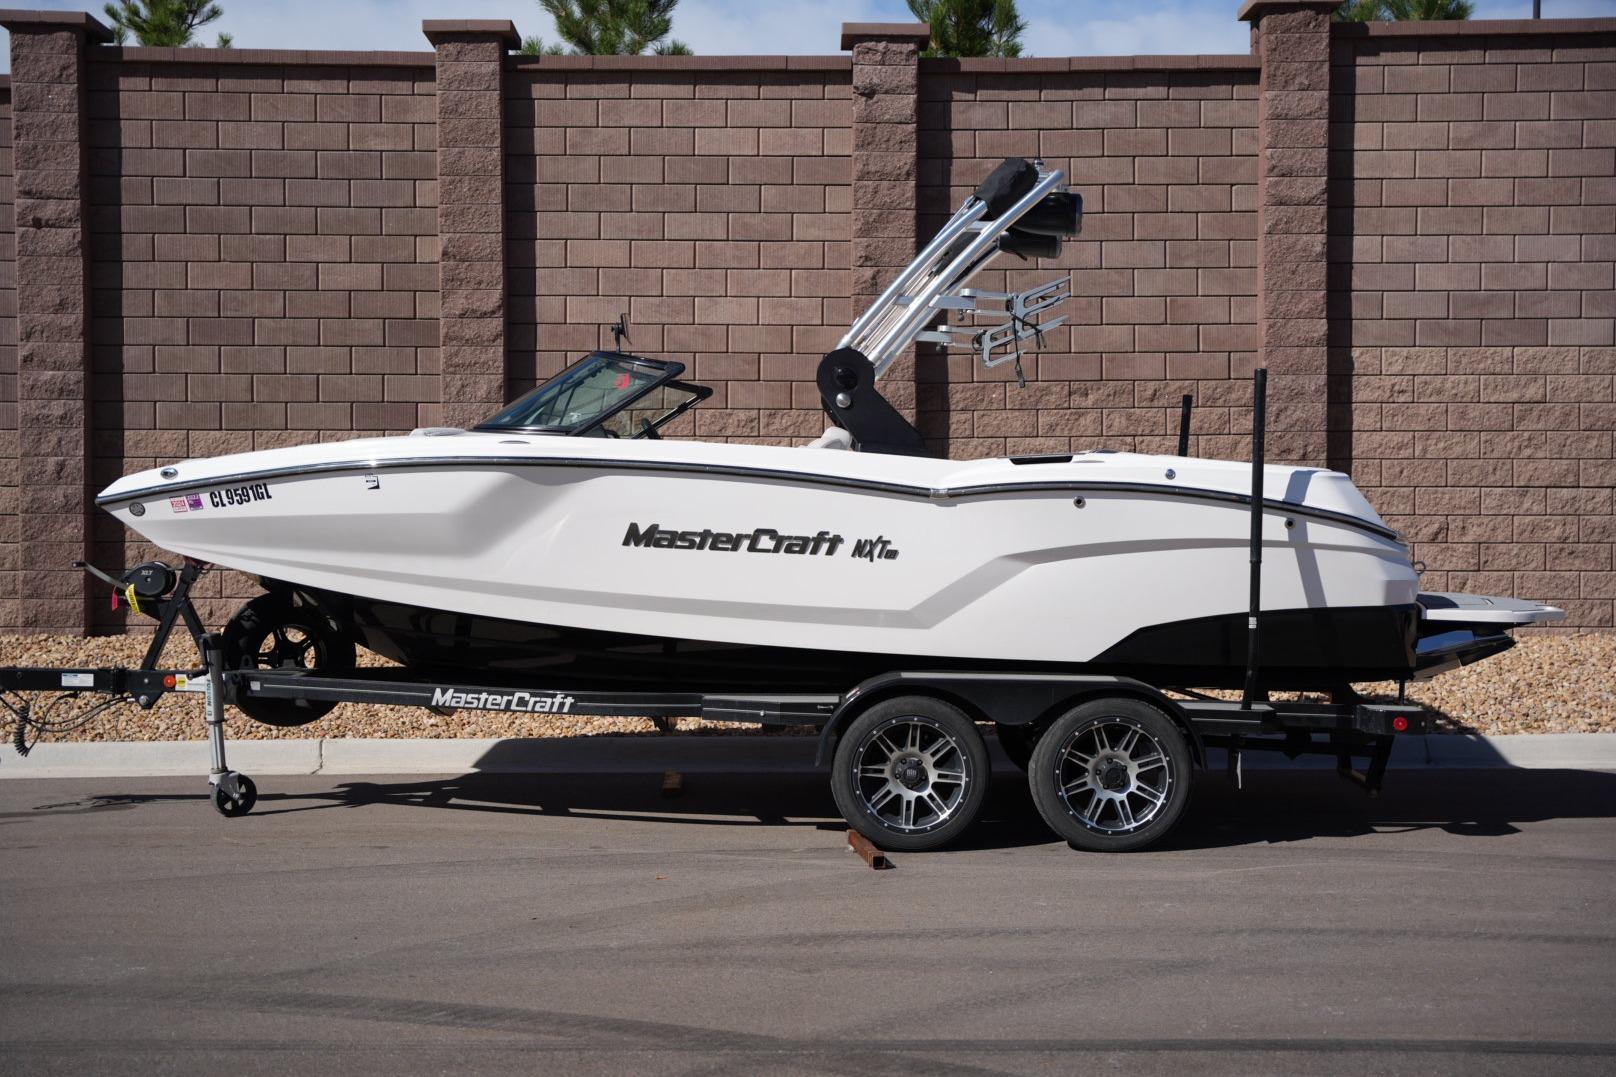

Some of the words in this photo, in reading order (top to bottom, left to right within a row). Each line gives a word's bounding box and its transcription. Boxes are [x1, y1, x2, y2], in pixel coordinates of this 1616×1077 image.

[622, 522, 844, 556] MasterCraft
[851, 535, 892, 562] NXT
[431, 687, 575, 713] MasterCraft
